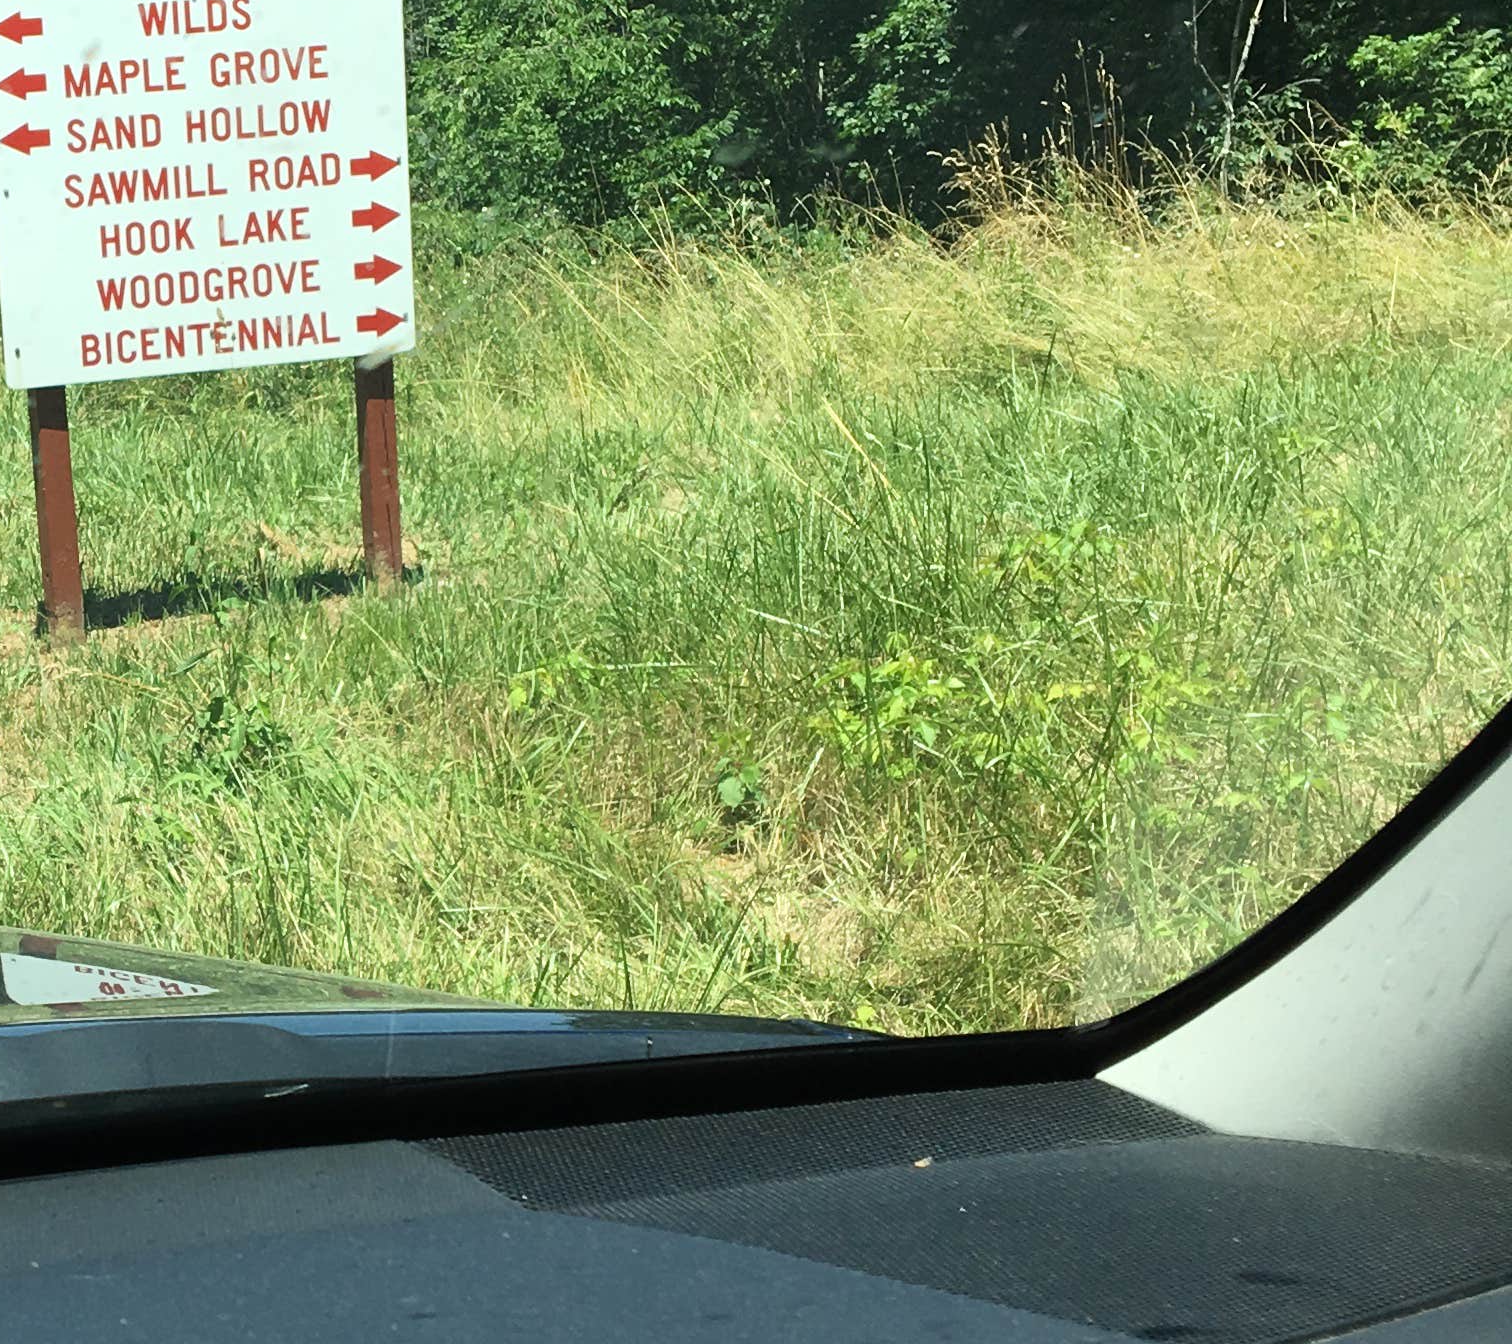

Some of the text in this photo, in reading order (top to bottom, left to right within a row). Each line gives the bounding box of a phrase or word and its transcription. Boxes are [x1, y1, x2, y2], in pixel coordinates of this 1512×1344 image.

[63, 45, 329, 98] MAPLE GROVE
[66, 99, 332, 154] SAND HOLLOW
[64, 152, 341, 208] SAWMILL ROAD
[100, 207, 311, 258] HOOK LAKE
[97, 259, 321, 311] WOODGROVE
[81, 312, 340, 367] BICENTENNIAL
